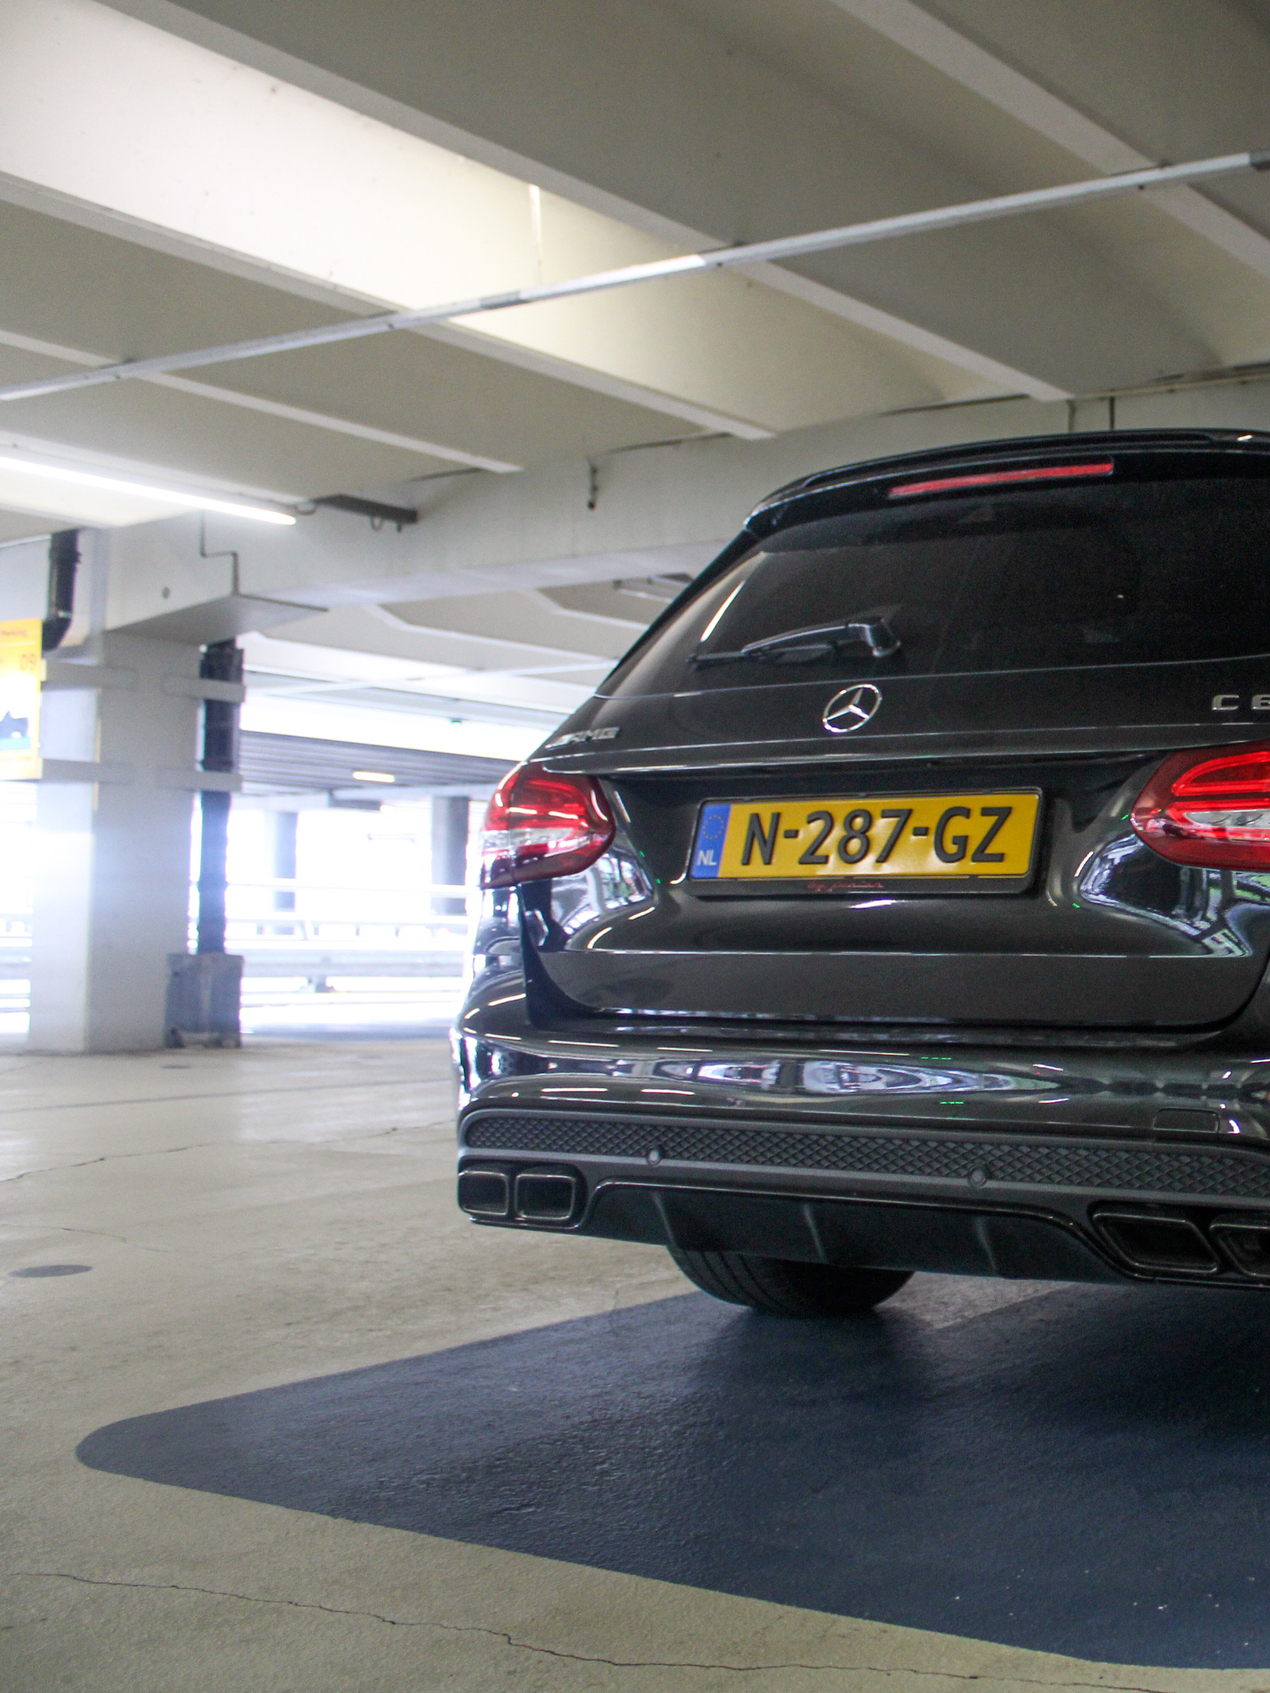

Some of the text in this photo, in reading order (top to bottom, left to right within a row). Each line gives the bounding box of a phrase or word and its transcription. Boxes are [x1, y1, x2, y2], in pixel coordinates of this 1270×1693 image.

[1211, 694, 1239, 710] C
[741, 806, 1012, 866] N-287-GZ
[697, 850, 717, 866] NL
